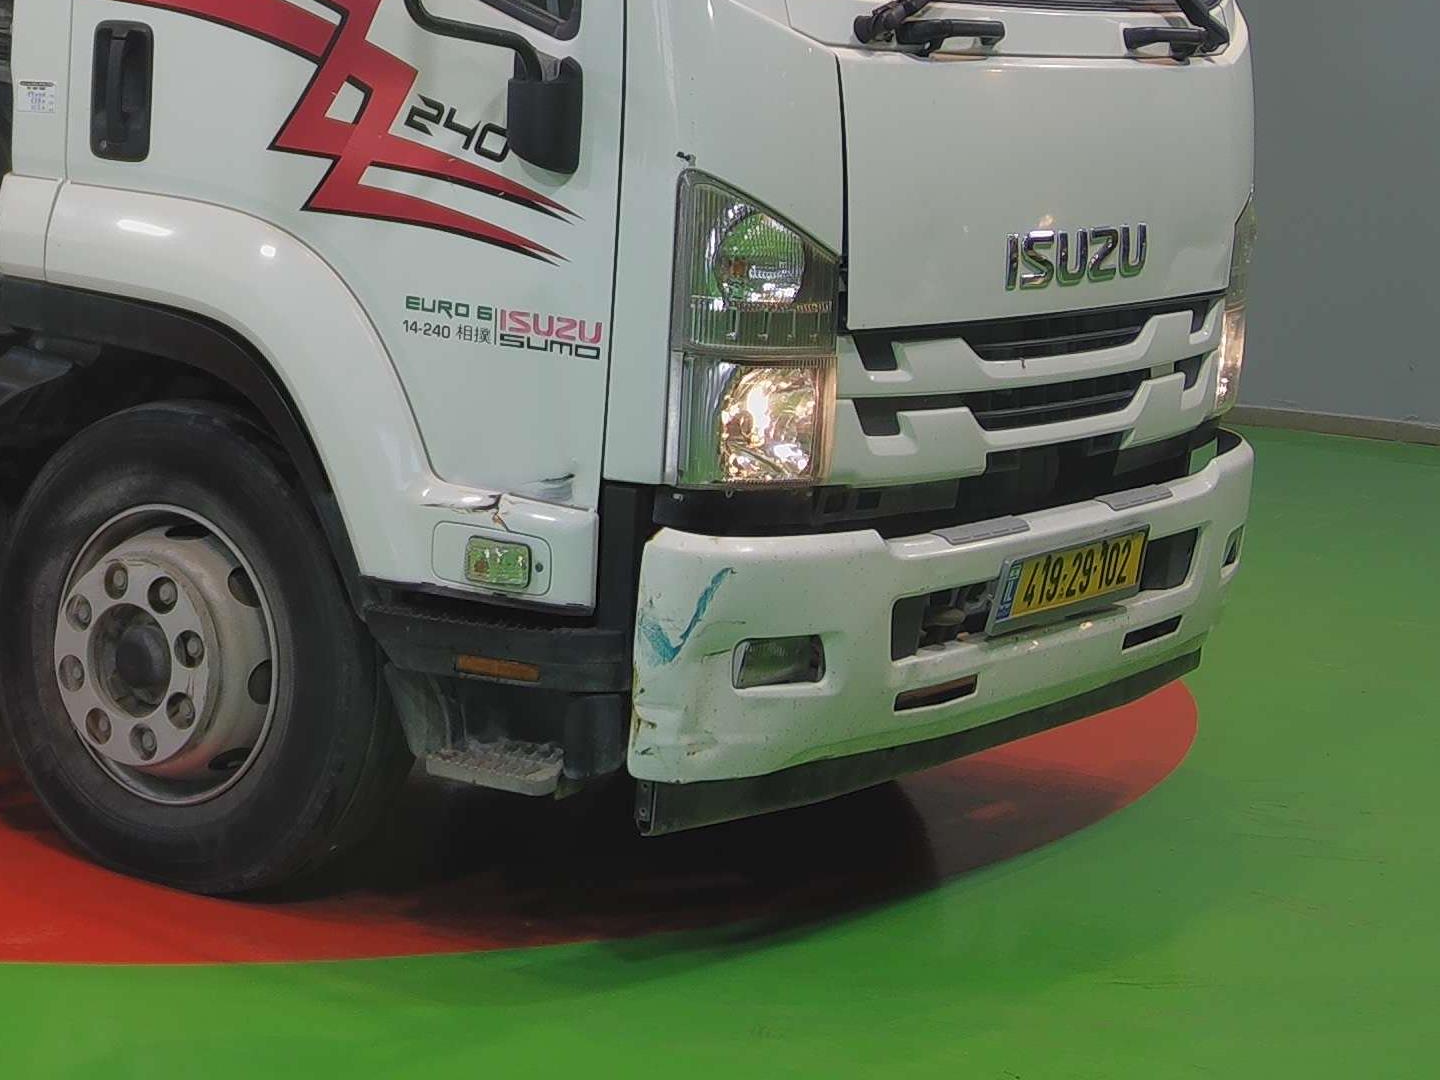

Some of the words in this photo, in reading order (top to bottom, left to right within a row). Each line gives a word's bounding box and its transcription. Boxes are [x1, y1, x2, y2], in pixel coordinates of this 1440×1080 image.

[403, 94, 510, 163] 240
[1005, 222, 1149, 291] ISUZU
[405, 295, 470, 320] EURO
[477, 305, 493, 321] 6
[402, 319, 451, 339] 14-240
[499, 308, 603, 345] ISUZU
[499, 333, 601, 361] SUMO
